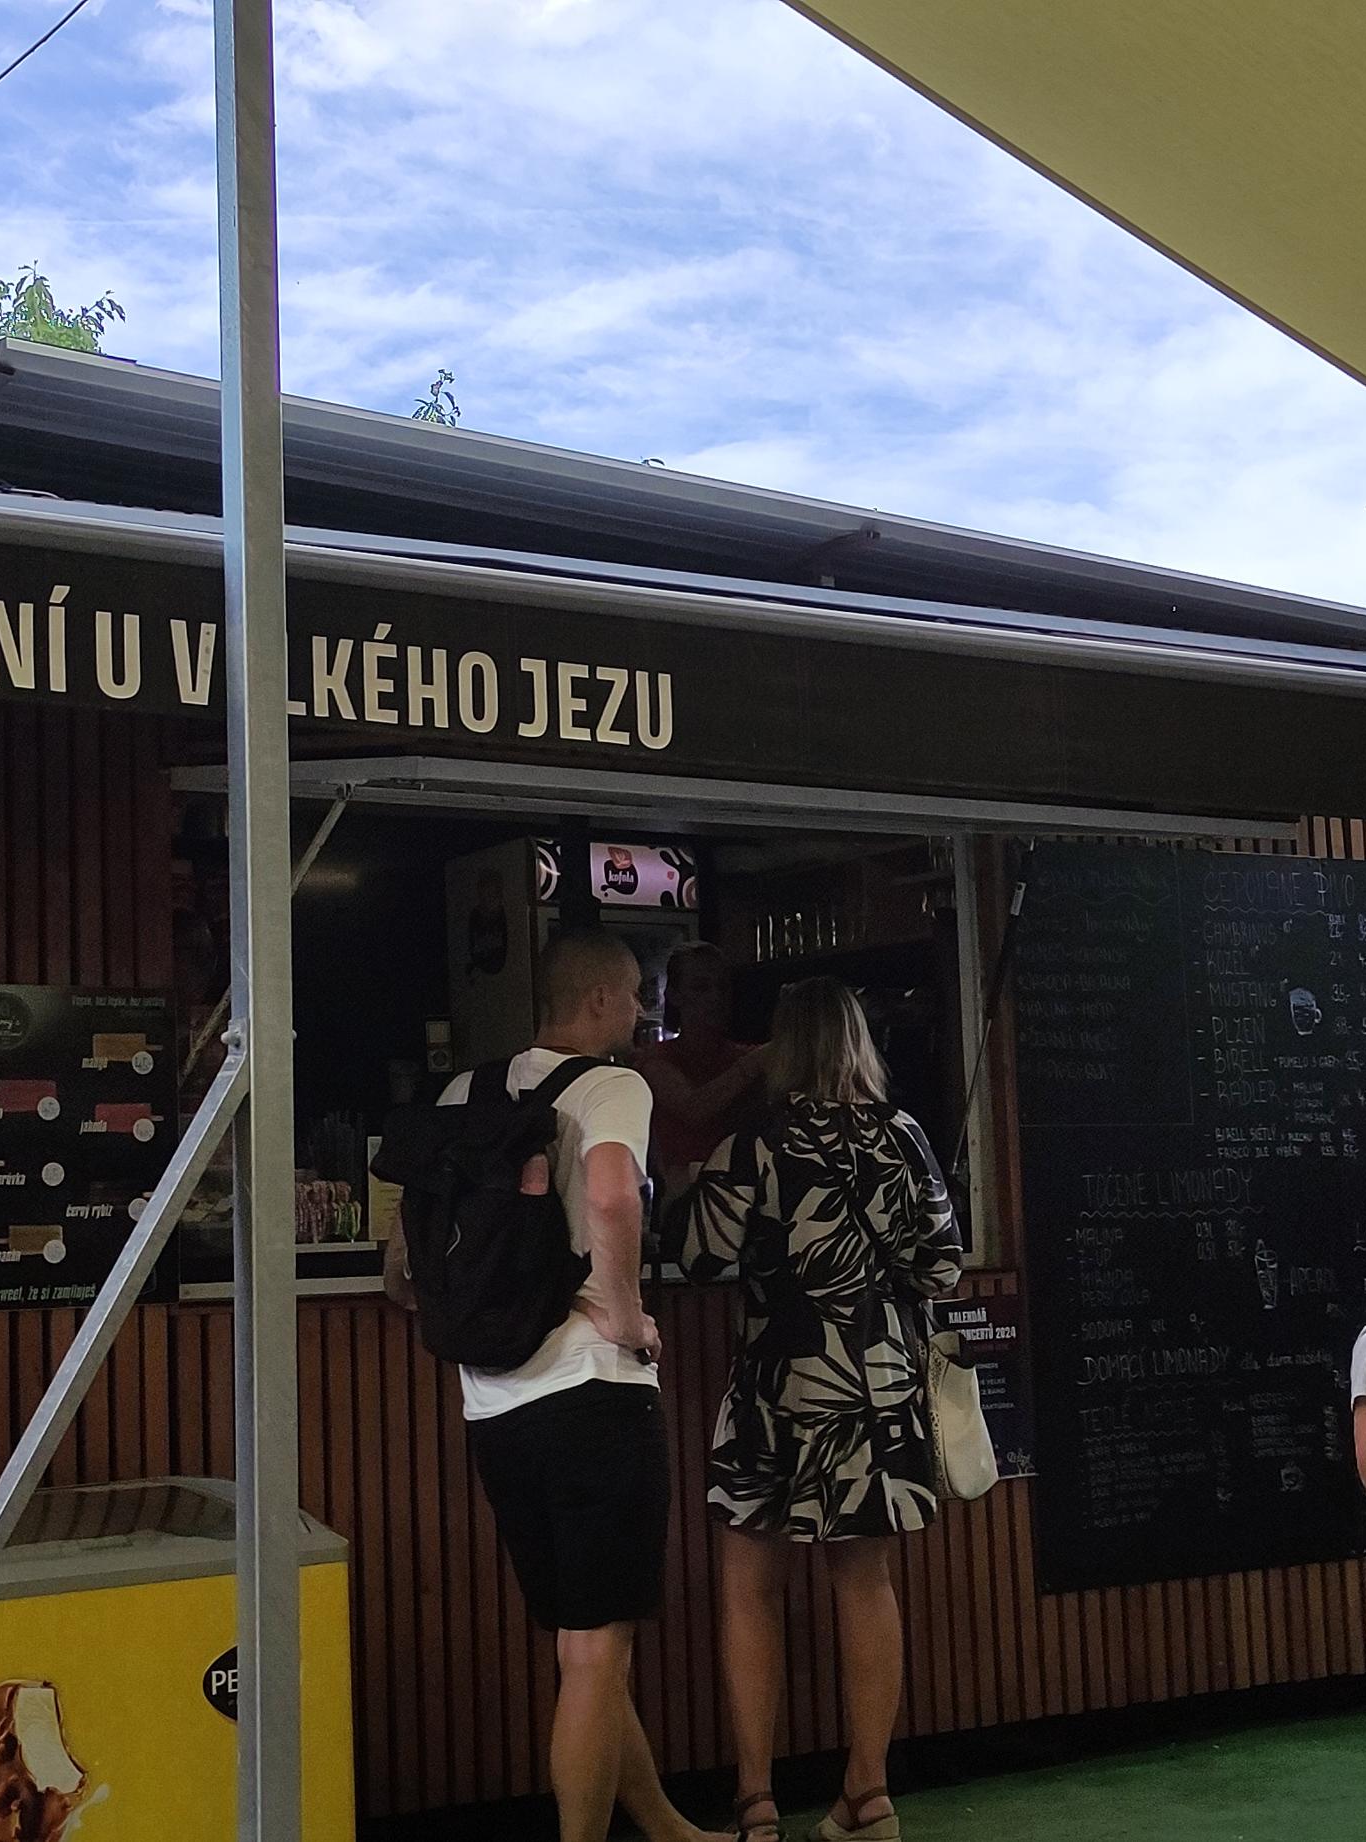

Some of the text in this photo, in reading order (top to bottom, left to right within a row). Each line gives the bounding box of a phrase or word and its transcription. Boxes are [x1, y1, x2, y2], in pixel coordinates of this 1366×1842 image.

[96, 610, 141, 699] U
[170, 618, 499, 734] VKÉHO
[519, 657, 674, 750] JEZU
[608, 870, 634, 885] kofola
[1208, 980, 1280, 1009] MUSTANG
[948, 1307, 987, 1325] KALENDÁŘ
[995, 1325, 1017, 1341] 2024
[211, 1668, 239, 1697] PE
